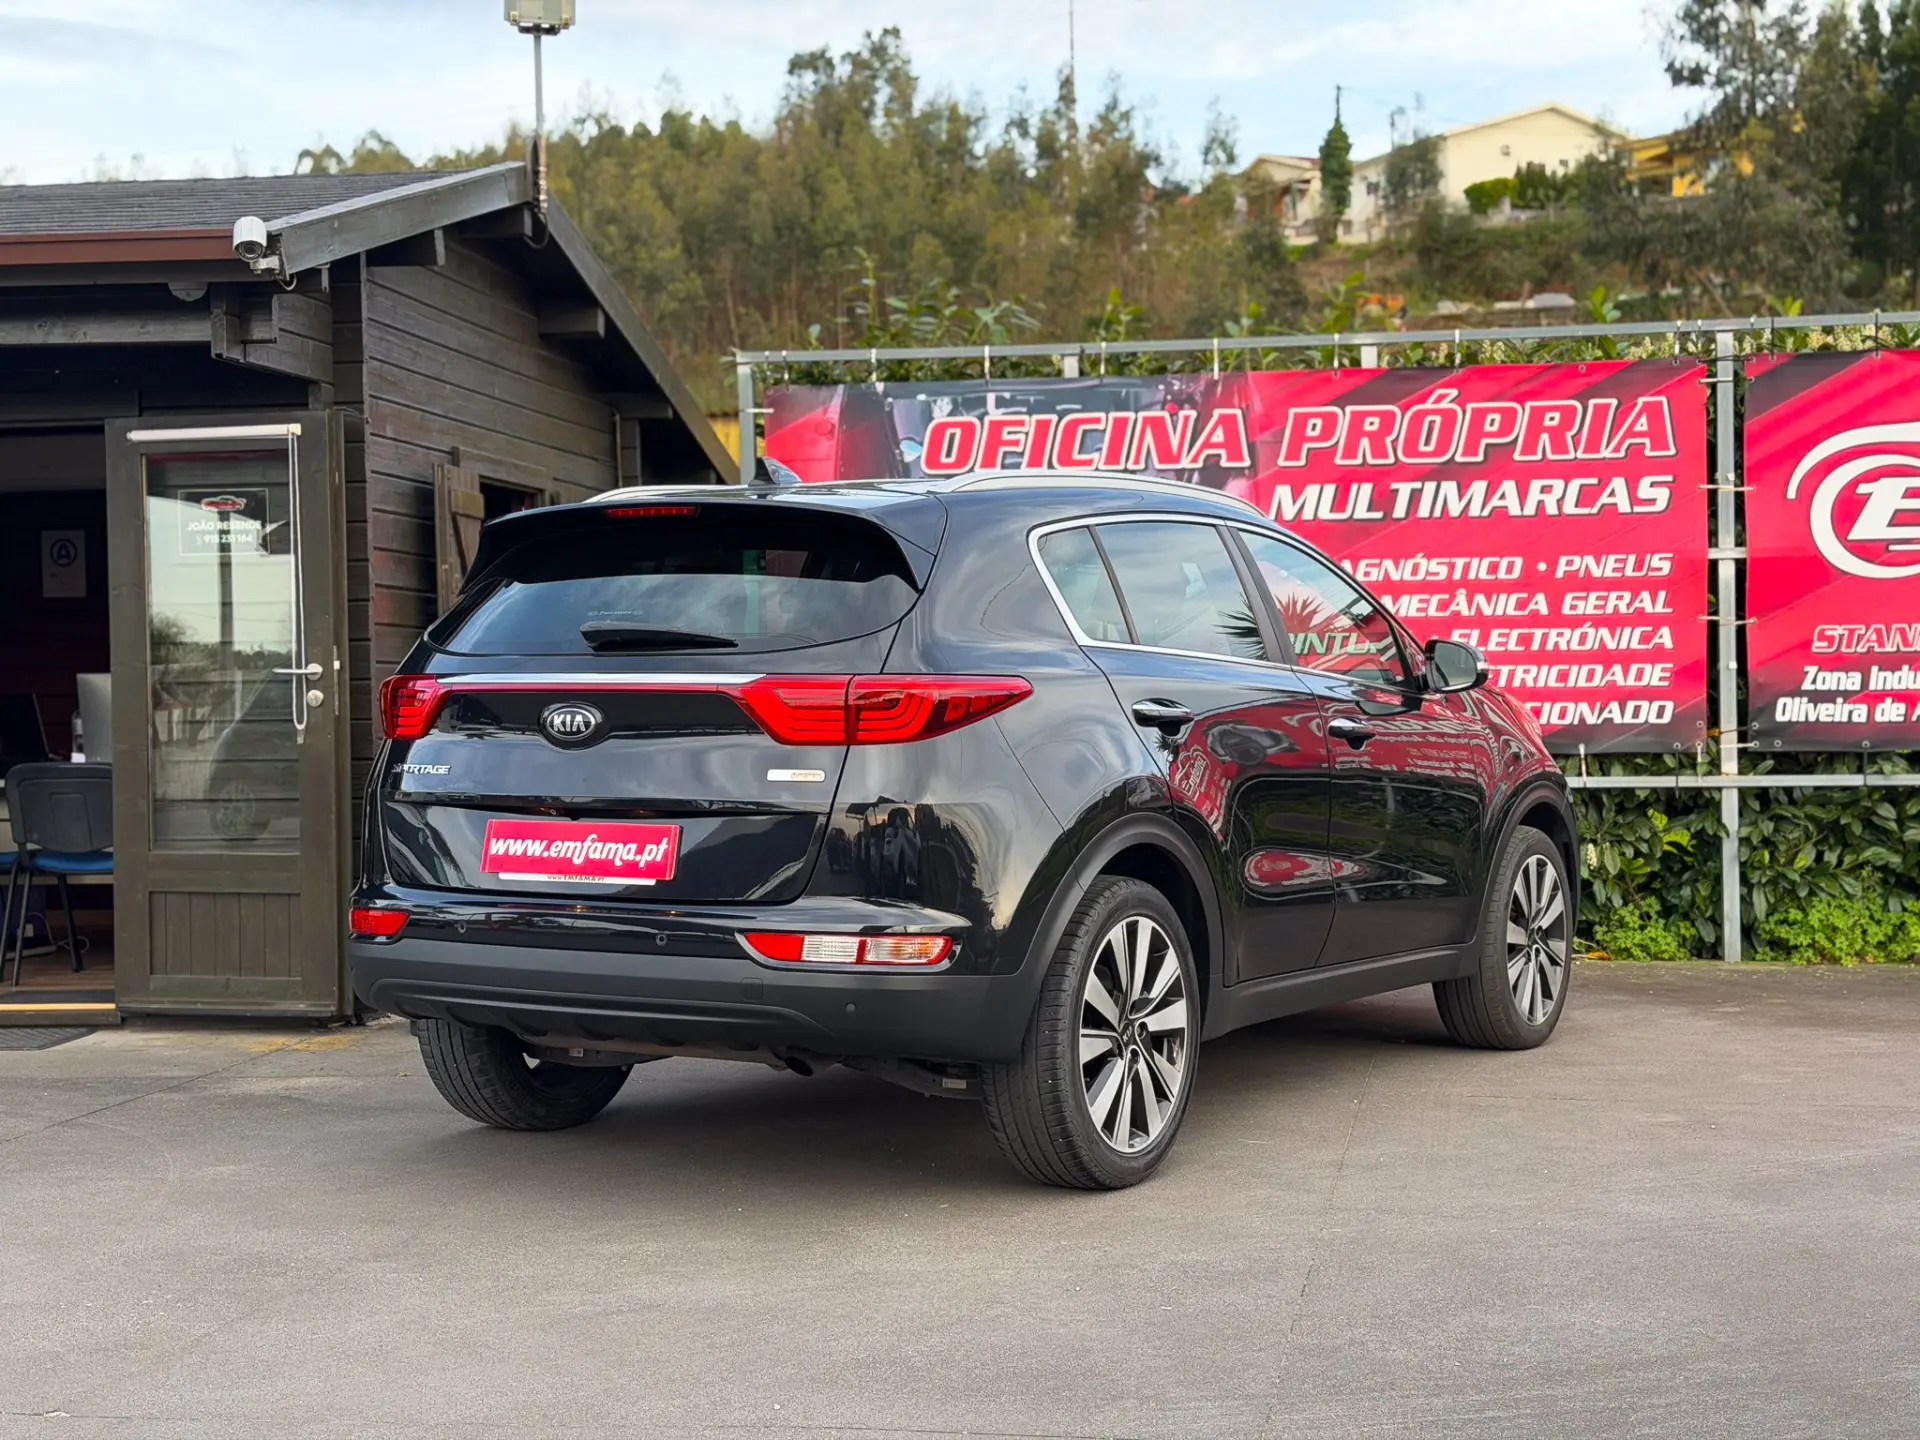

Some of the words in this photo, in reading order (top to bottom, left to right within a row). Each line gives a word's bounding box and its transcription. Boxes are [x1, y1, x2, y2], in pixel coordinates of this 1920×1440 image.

[920, 407, 1252, 475] OFICINA
[1277, 388, 1678, 467] PRÓPRIA
[1268, 475, 1675, 521] MULTIMARCAS
[187, 519, 214, 531] JOÃO
[216, 520, 262, 530] RESENDE
[1554, 552, 1674, 579] PNEUS
[1379, 588, 1549, 618] MECÂNICA
[1561, 590, 1674, 616] GERAL
[1488, 663, 1674, 688] TRICIDADE
[1800, 665, 1862, 690] Zona
[553, 714, 587, 732] KIA
[1774, 696, 1869, 723] Oliveira
[1874, 696, 1906, 722] de
[490, 833, 669, 868] www.emfama.pt
